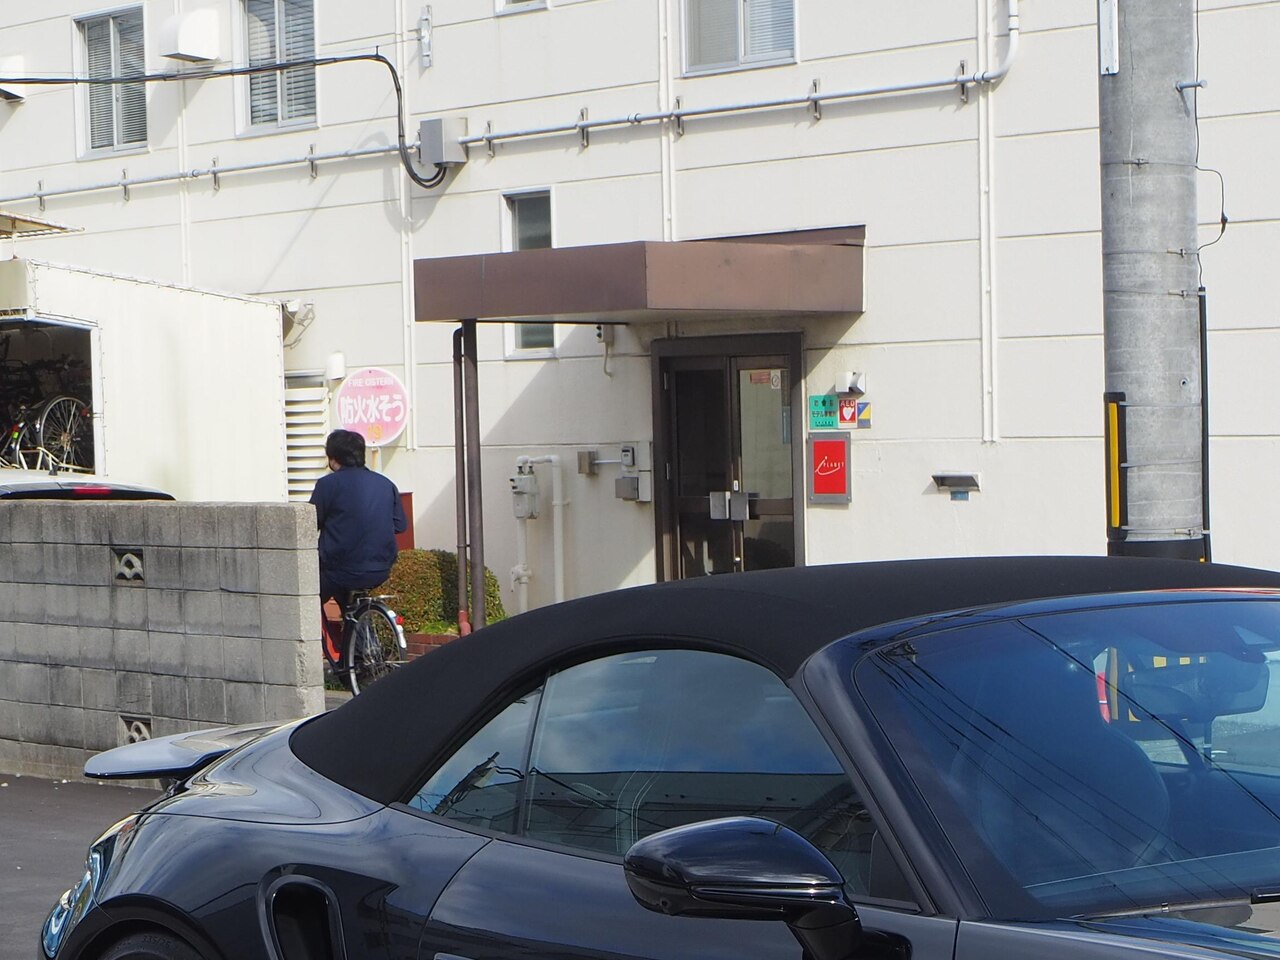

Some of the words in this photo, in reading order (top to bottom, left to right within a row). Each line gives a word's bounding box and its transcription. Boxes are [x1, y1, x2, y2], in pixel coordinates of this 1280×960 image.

[340, 394, 405, 424] 防火水そう
